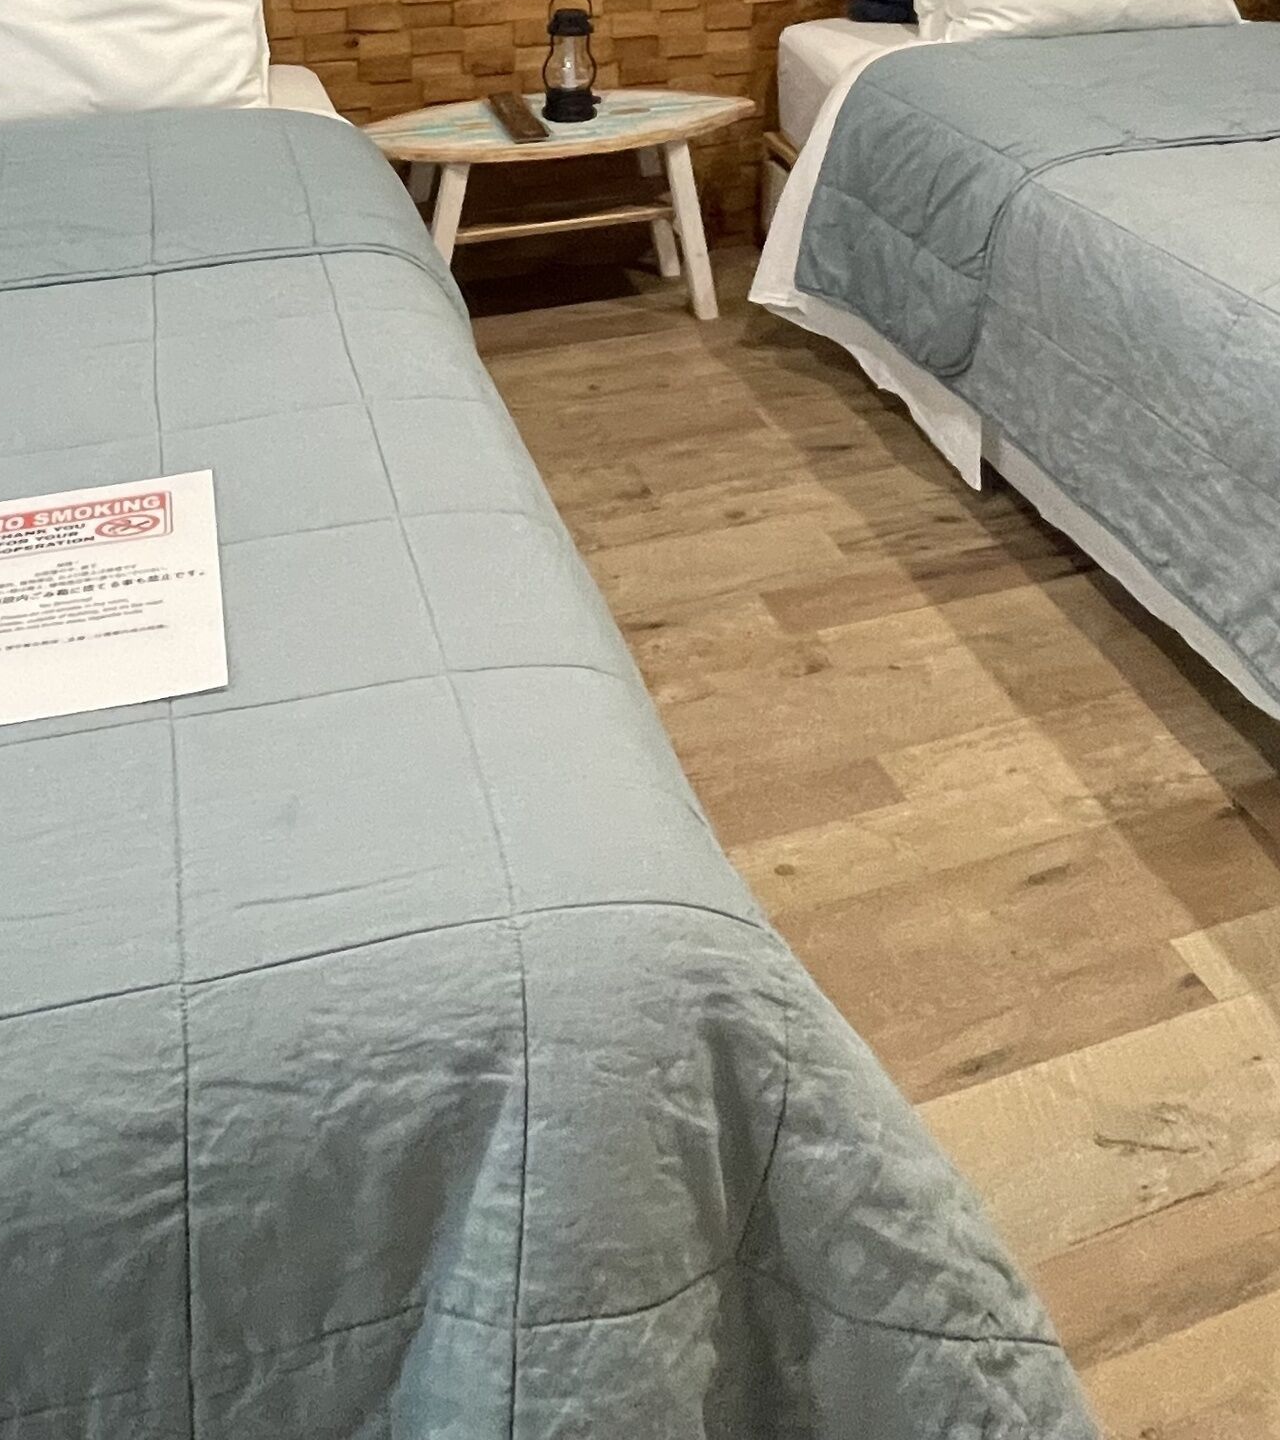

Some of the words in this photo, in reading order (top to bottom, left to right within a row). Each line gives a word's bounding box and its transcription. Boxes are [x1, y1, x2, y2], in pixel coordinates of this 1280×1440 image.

[33, 495, 162, 526] SMOKING
[54, 523, 87, 532] YOU
[34, 531, 79, 542] YOUR
